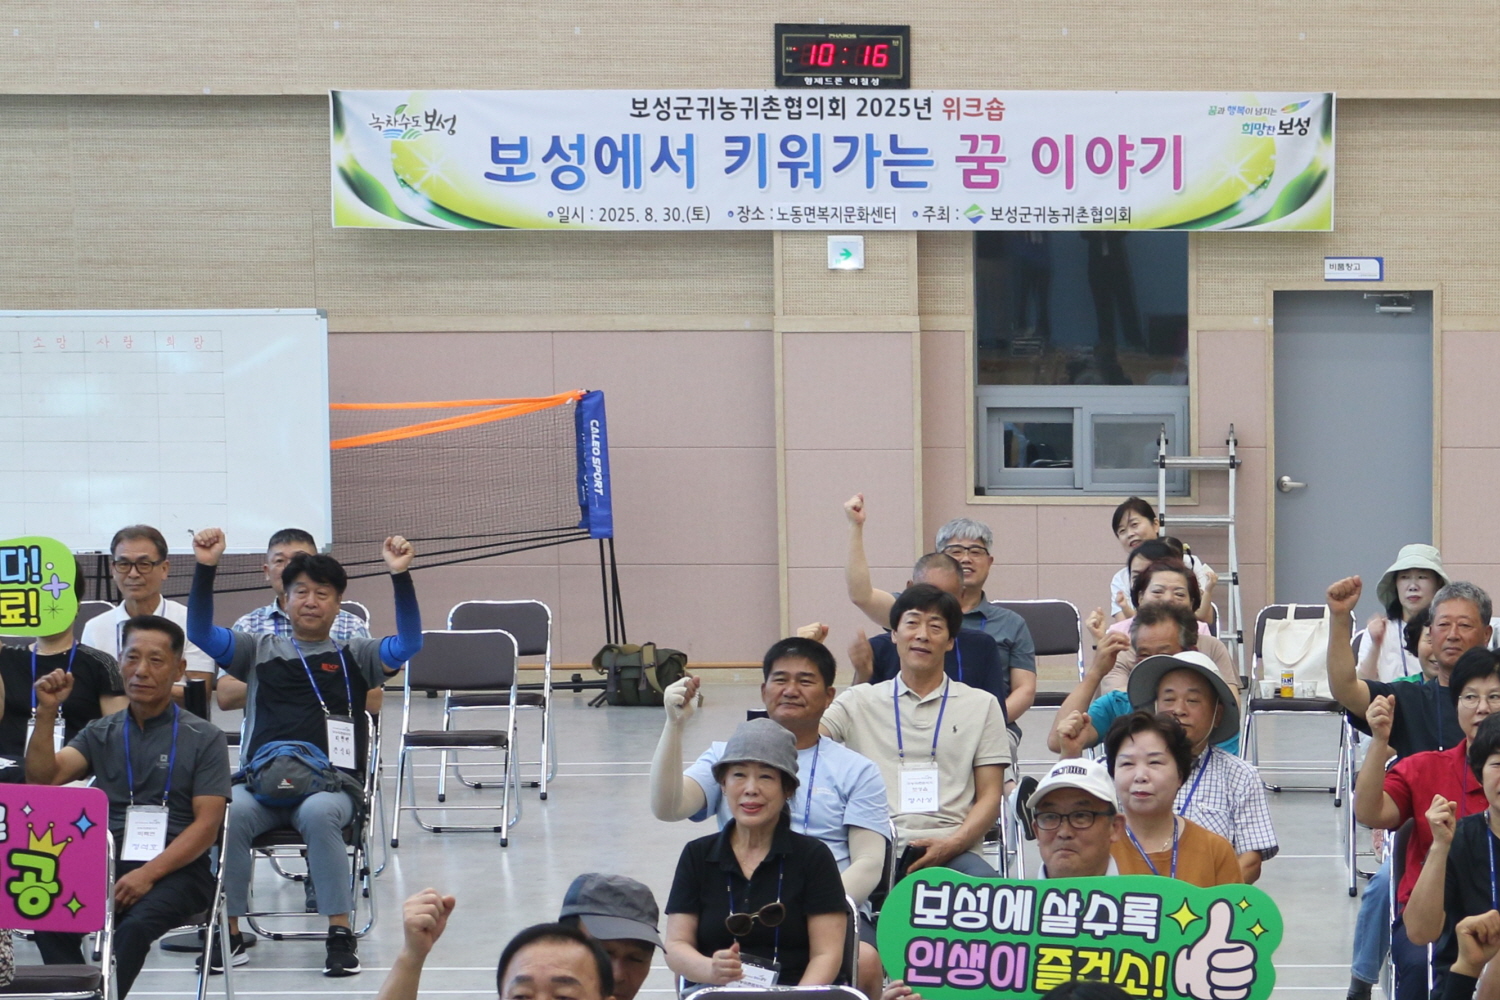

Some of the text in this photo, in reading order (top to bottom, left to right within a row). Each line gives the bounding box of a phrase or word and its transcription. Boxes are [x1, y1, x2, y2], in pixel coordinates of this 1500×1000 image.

[368, 108, 457, 136] 녹차수도 보성
[630, 96, 1006, 122] 보성군귀농귀촌협의회 2025년 위크숍
[1208, 105, 1277, 116] 꿈과 행복이 넘치는
[1241, 117, 1311, 136] 희망찬 보성
[484, 133, 1182, 191] 보성에서 키워가는 꿈 이야기
[557, 206, 585, 223] 일시
[599, 207, 640, 222] 2025.
[645, 207, 658, 222] 8.
[663, 206, 711, 224] 30.(토)
[737, 206, 765, 222] 장소
[776, 206, 897, 224] 노동면복지문화센터
[922, 206, 950, 223] 주최
[990, 206, 1132, 224] 보성군귀농귀촌협의회
[589, 419, 604, 496] CALEO SPORT
[911, 880, 1162, 941] 보성에 살수록
[905, 938, 1029, 990] 인생이
